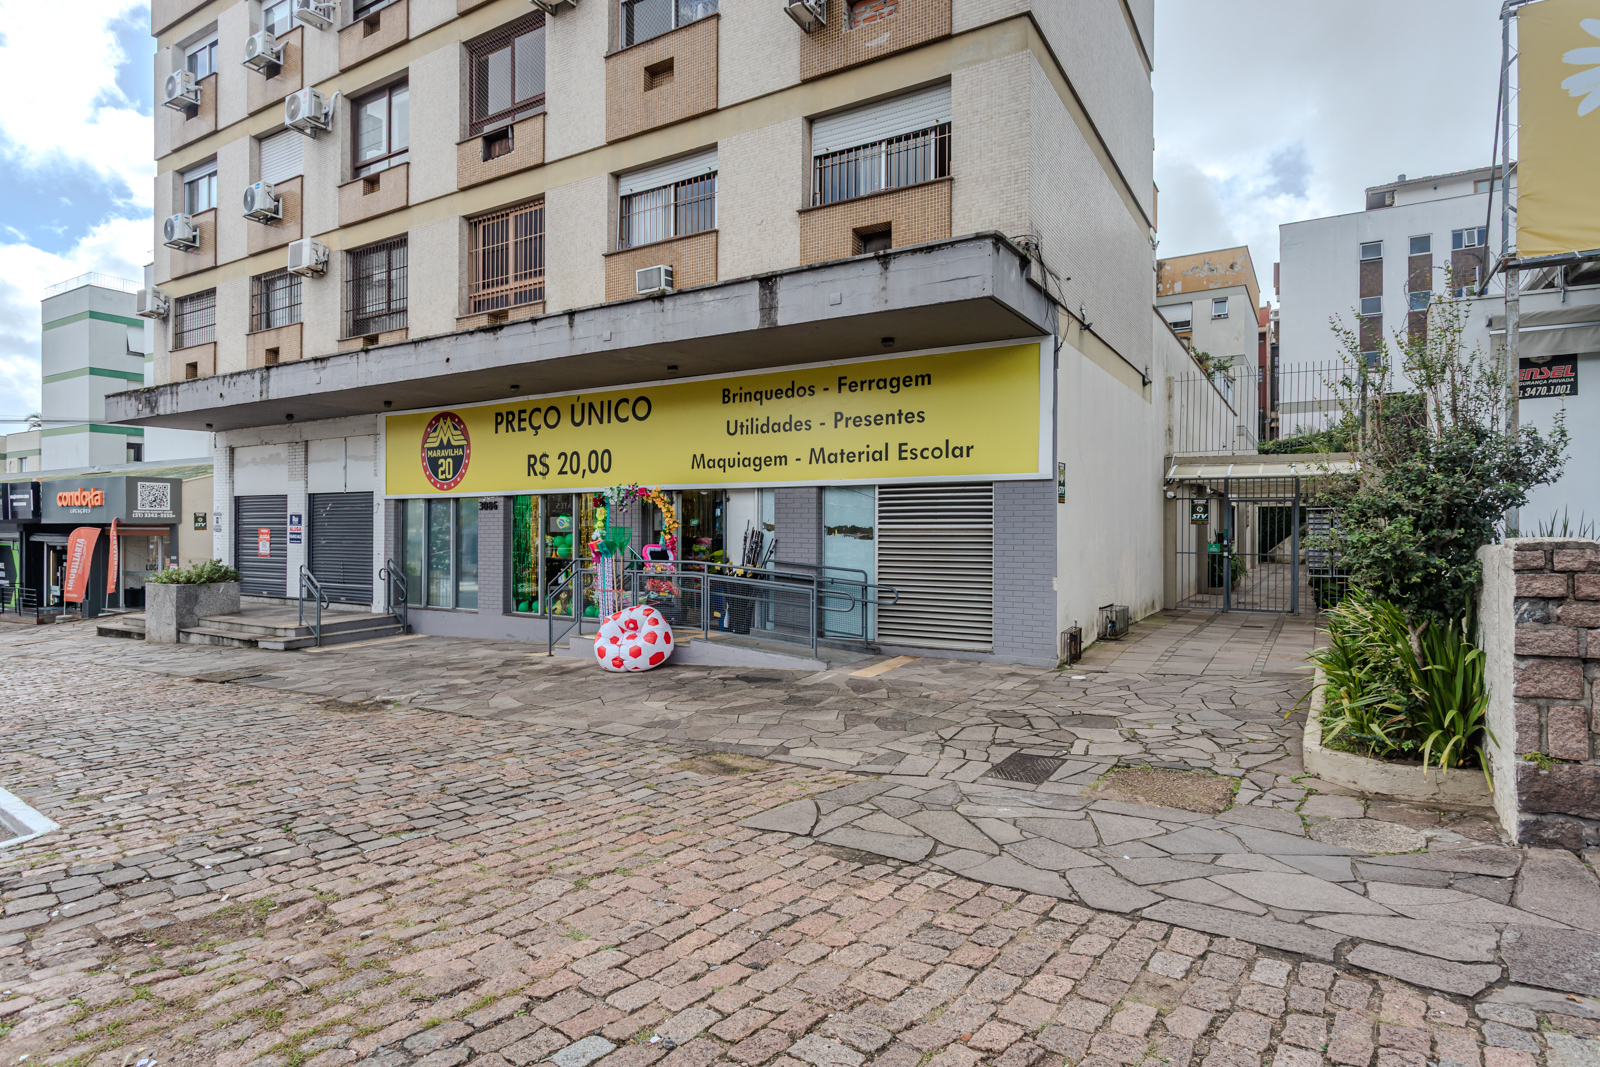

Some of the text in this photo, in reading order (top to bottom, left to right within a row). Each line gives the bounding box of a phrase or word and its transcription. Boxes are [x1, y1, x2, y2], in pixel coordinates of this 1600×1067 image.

[1519, 365, 1575, 380] ENSEL
[721, 380, 816, 406] Brinquedos
[837, 373, 932, 394] Ferragem
[1525, 385, 1571, 397] 3470.1001
[494, 395, 652, 436] PREÇO ÚNICO
[726, 414, 812, 436] Utilidades
[833, 408, 926, 429] Presentes
[427, 447, 463, 458] MARAVILHA
[527, 449, 612, 480] R$ 20,00
[691, 451, 788, 473] Maquiagem
[808, 442, 889, 465] Material
[898, 439, 974, 461] Escolar
[438, 458, 453, 479] 20
[478, 501, 499, 511] 3086
